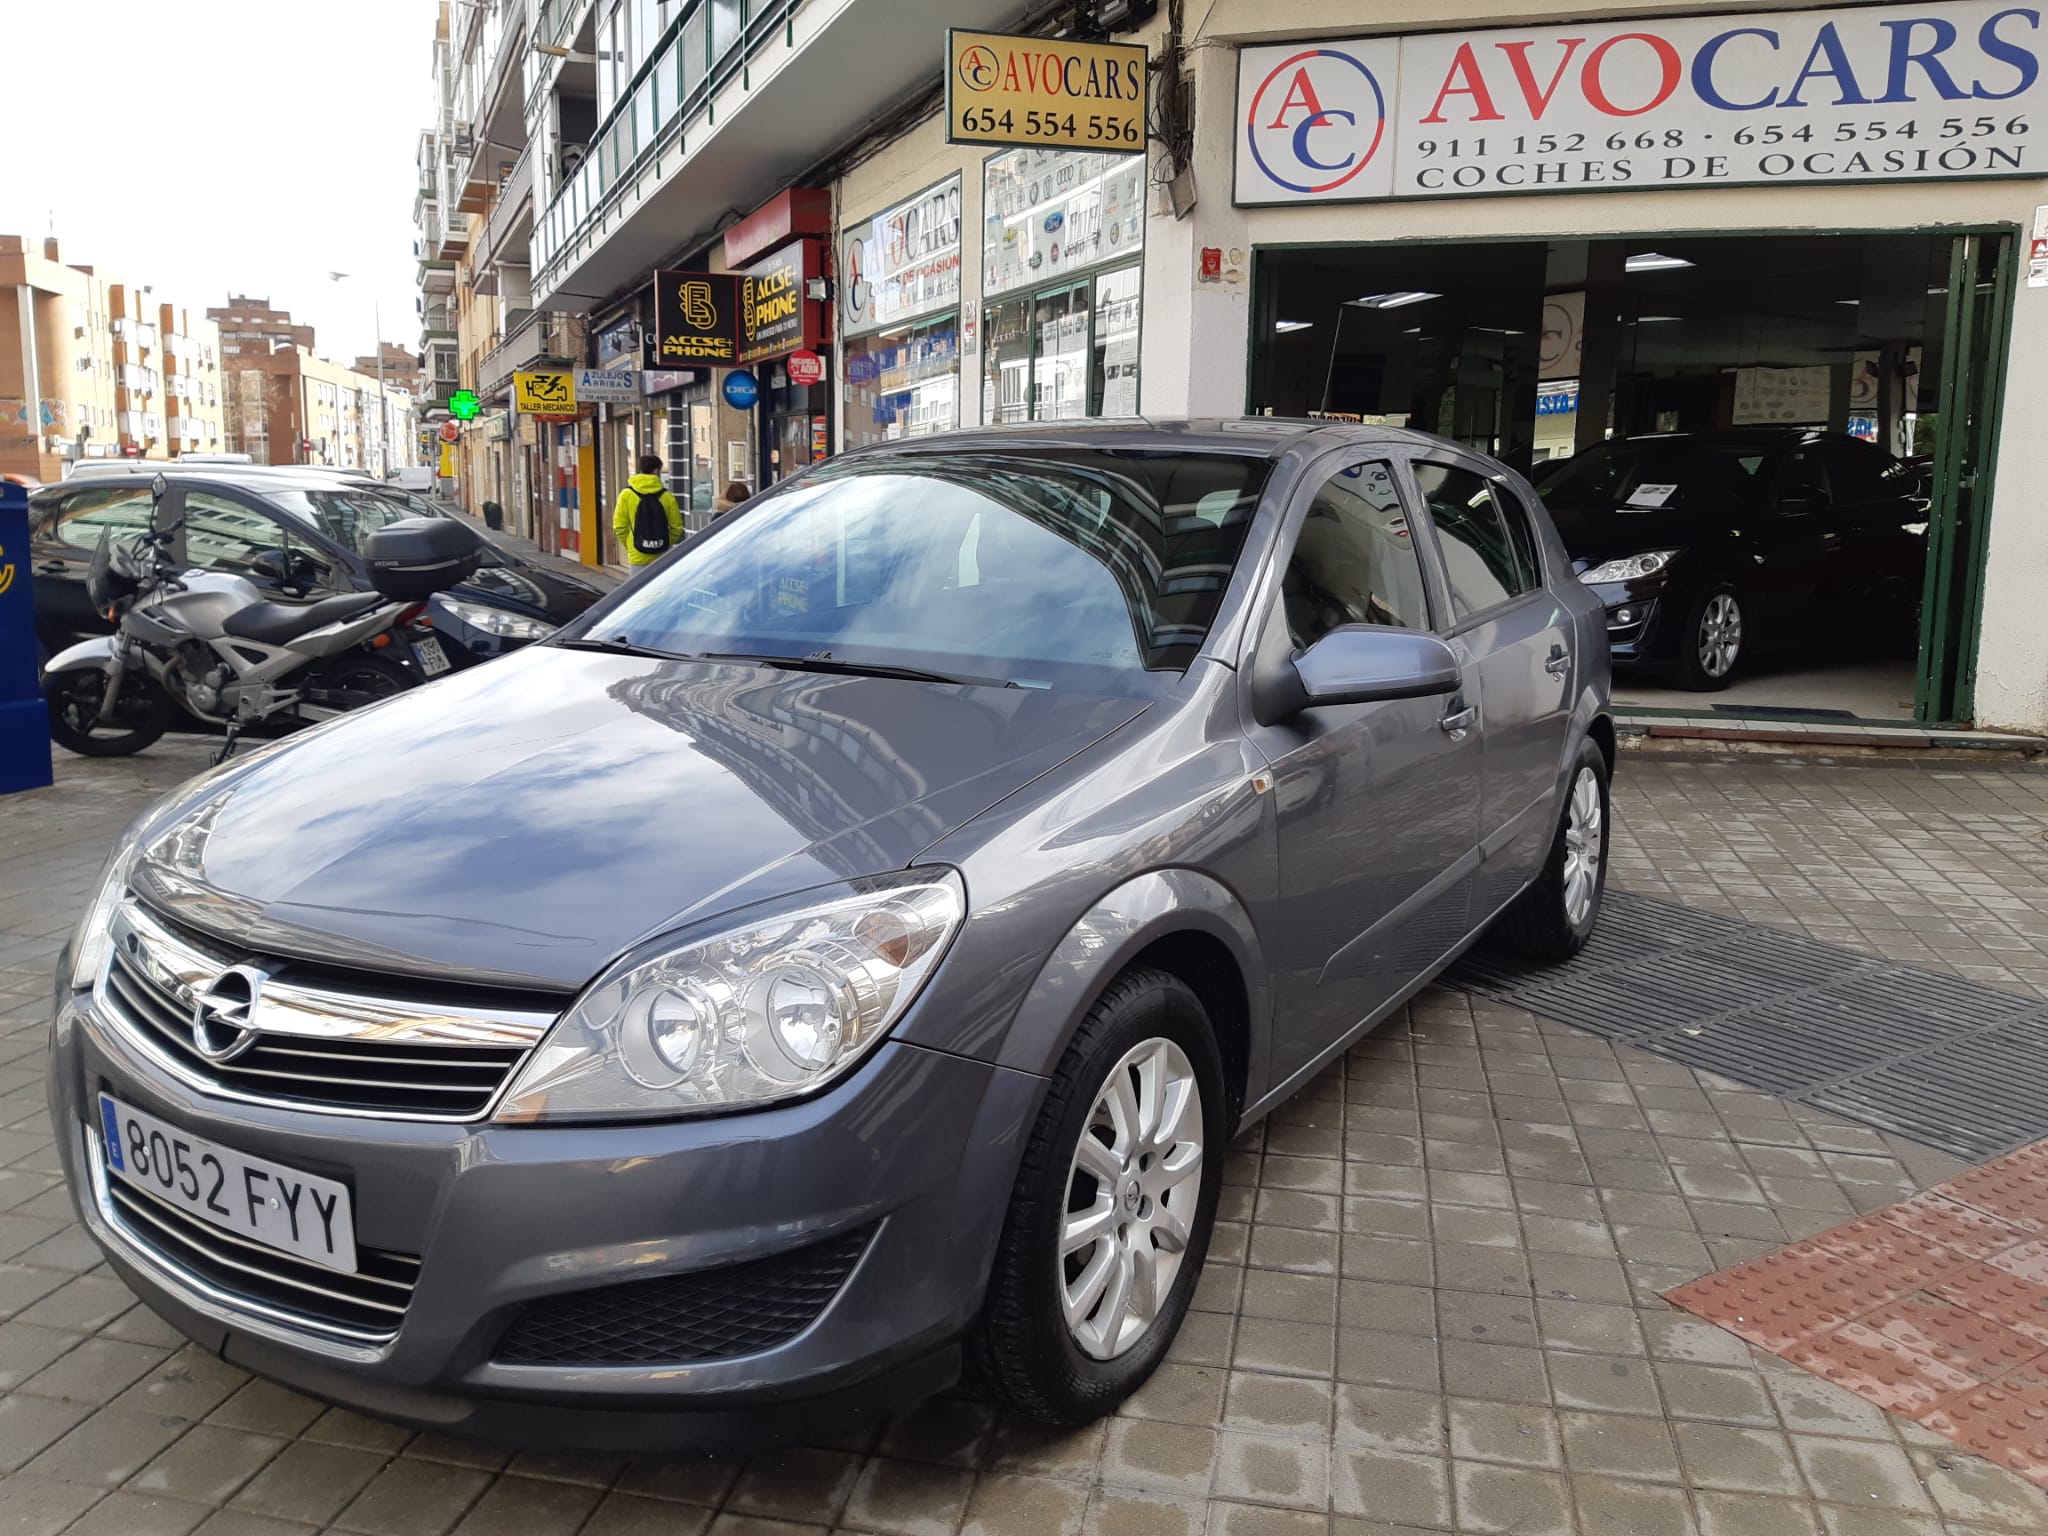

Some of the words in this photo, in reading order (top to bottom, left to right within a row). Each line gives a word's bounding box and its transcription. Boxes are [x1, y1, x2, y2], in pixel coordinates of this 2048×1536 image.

[1002, 50, 1139, 101] AVOCARS
[1418, 7, 2041, 125] AVOCARS
[962, 106, 1014, 134] 654
[1025, 111, 1077, 138] 554
[1088, 115, 1138, 143] 556
[1418, 138, 1488, 159] 911
[1513, 133, 1586, 155] 152
[1606, 129, 1684, 151] 668
[1734, 124, 1813, 145] 654
[1834, 119, 1919, 142] 554
[1939, 114, 2030, 139] 556
[1416, 159, 1632, 189] COCHES
[1660, 155, 1729, 180] DE
[1758, 141, 2027, 175] OCASIÓN
[756, 289, 797, 327] PHONE
[662, 345, 733, 358] PHONE
[520, 402, 541, 411] TALLER
[726, 385, 757, 394] DIGI
[110, 1142, 119, 1158] E
[126, 1118, 230, 1217] 8052
[243, 1166, 337, 1255] FYY
